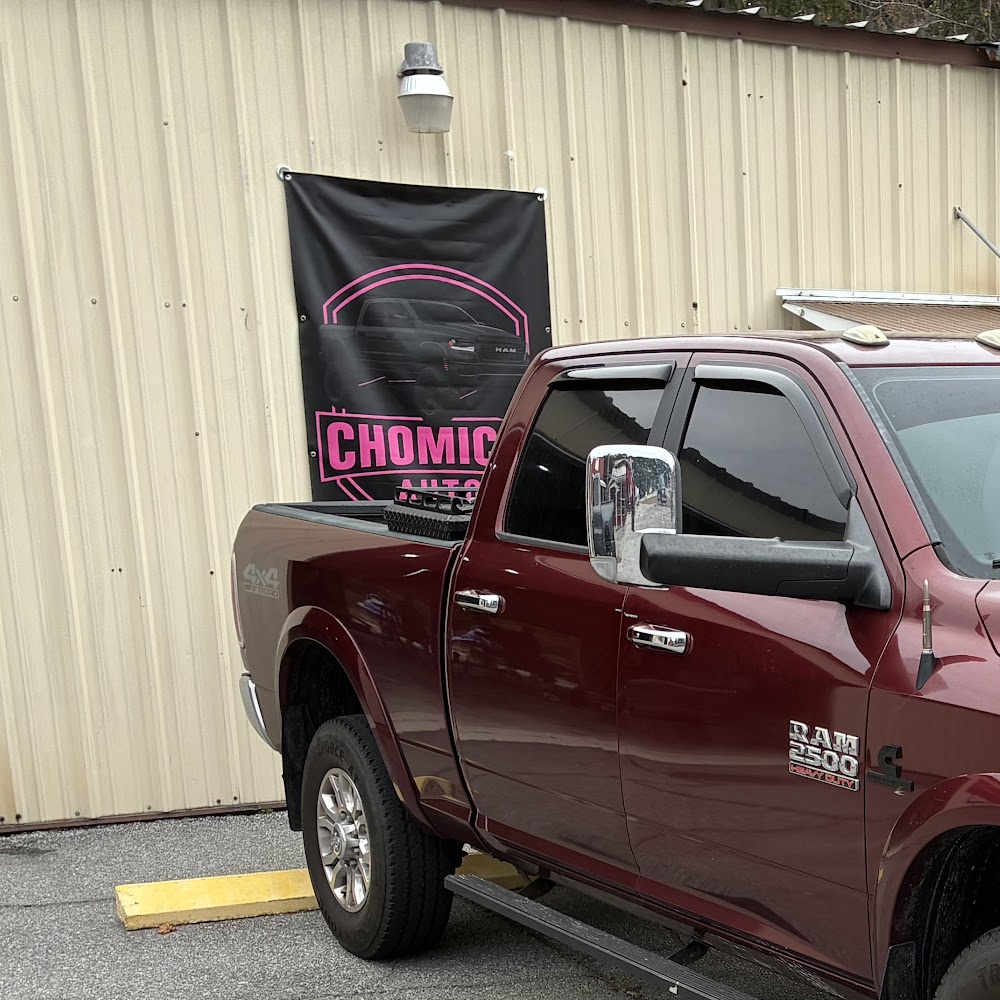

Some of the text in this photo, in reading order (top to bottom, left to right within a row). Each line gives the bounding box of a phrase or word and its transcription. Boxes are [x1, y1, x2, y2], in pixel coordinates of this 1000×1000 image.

[789, 720, 860, 757] RAM
[788, 740, 859, 777] 2500
[790, 763, 824, 781] HEAVY
[824, 773, 855, 789] DUTY
